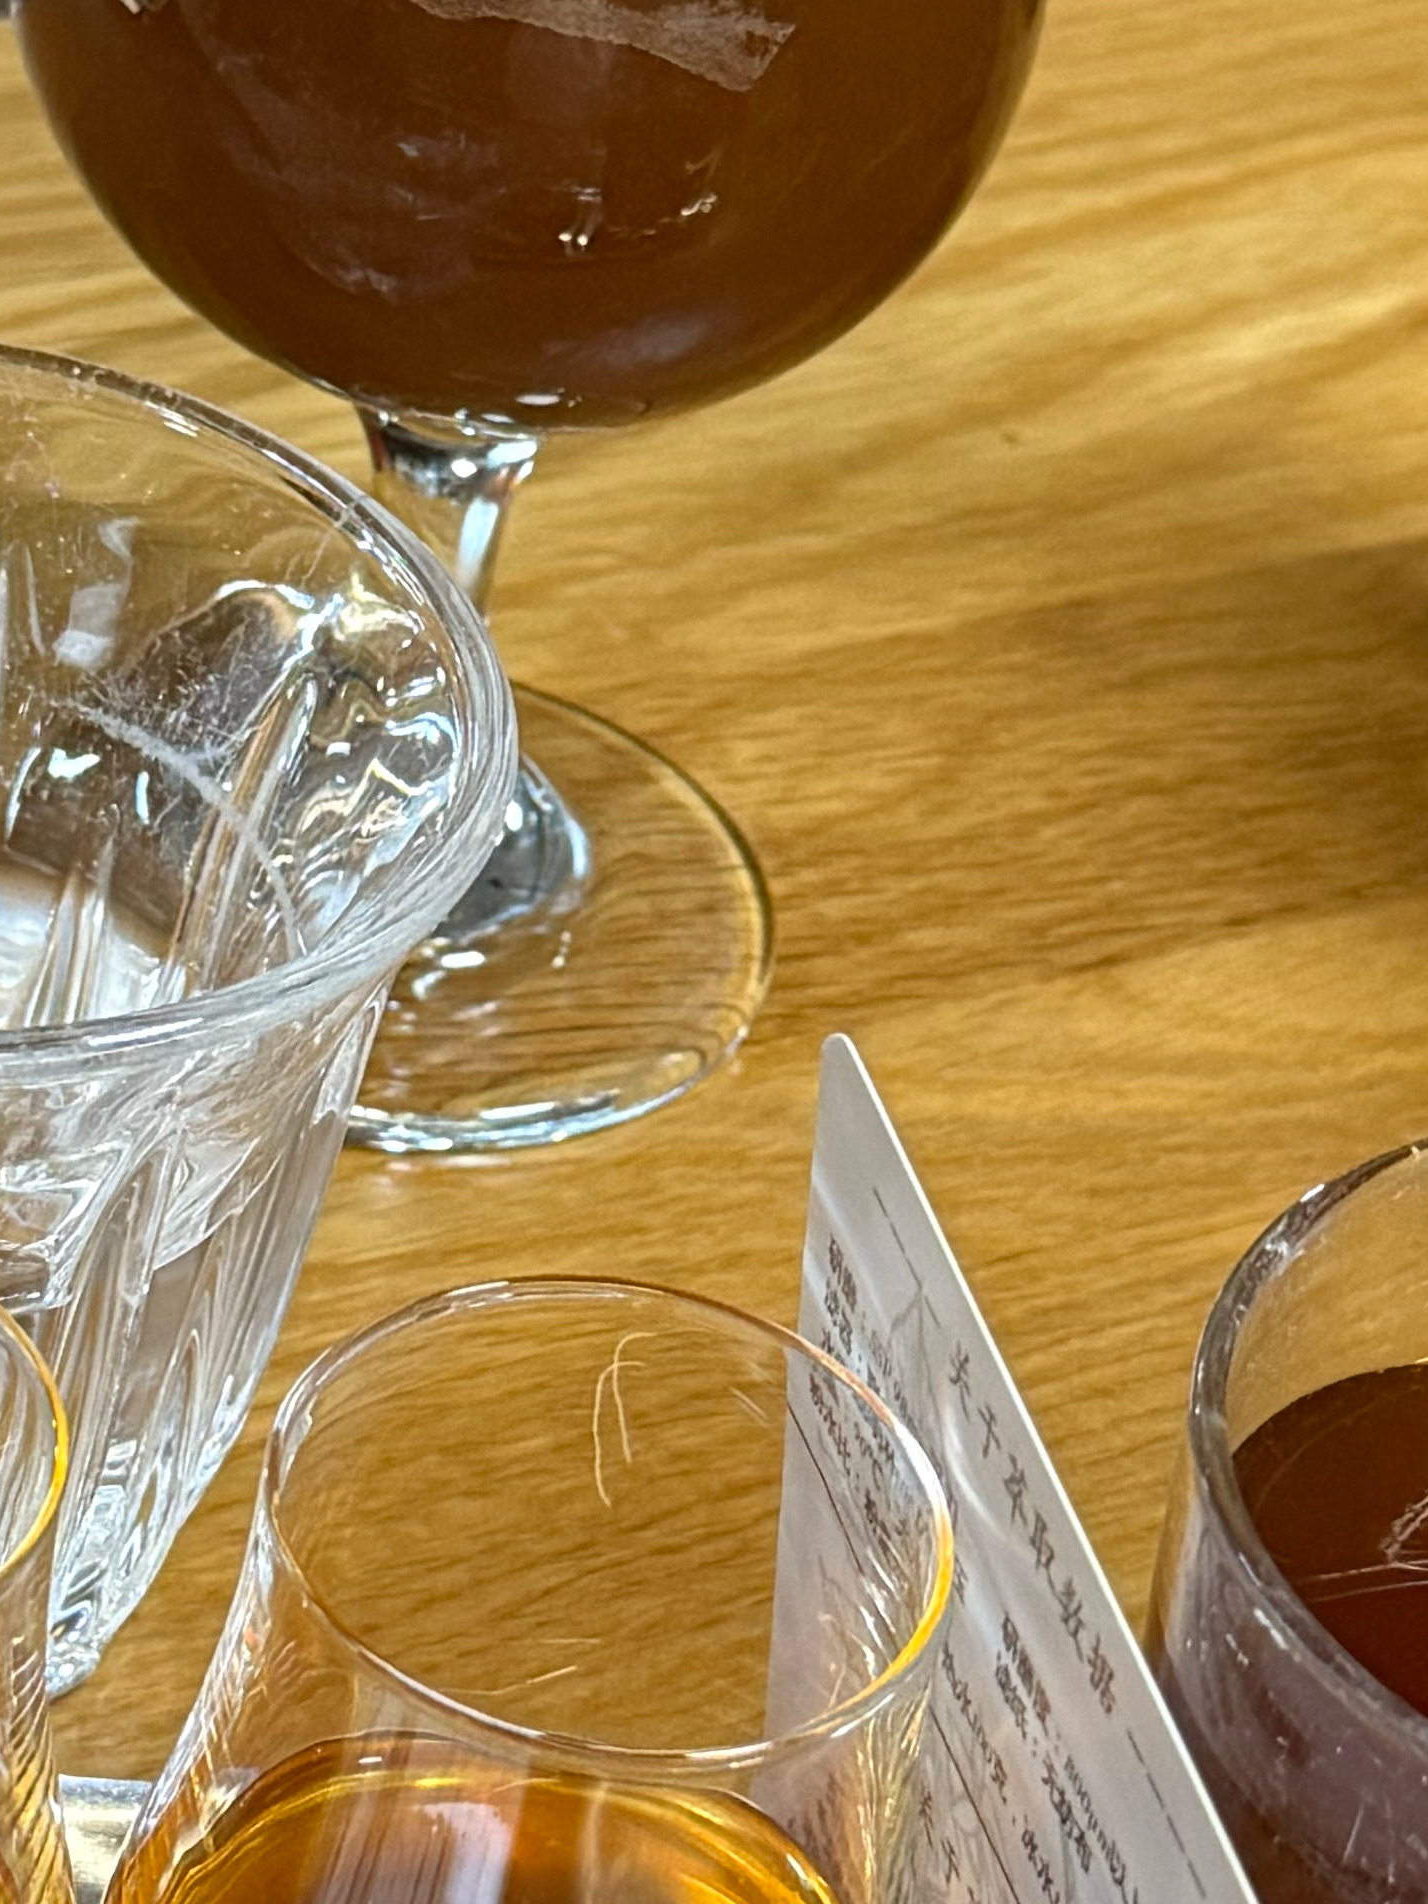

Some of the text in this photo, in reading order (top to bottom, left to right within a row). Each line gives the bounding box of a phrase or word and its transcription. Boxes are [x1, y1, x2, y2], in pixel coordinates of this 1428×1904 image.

[947, 1339, 1117, 1717] 关于萃取数据
